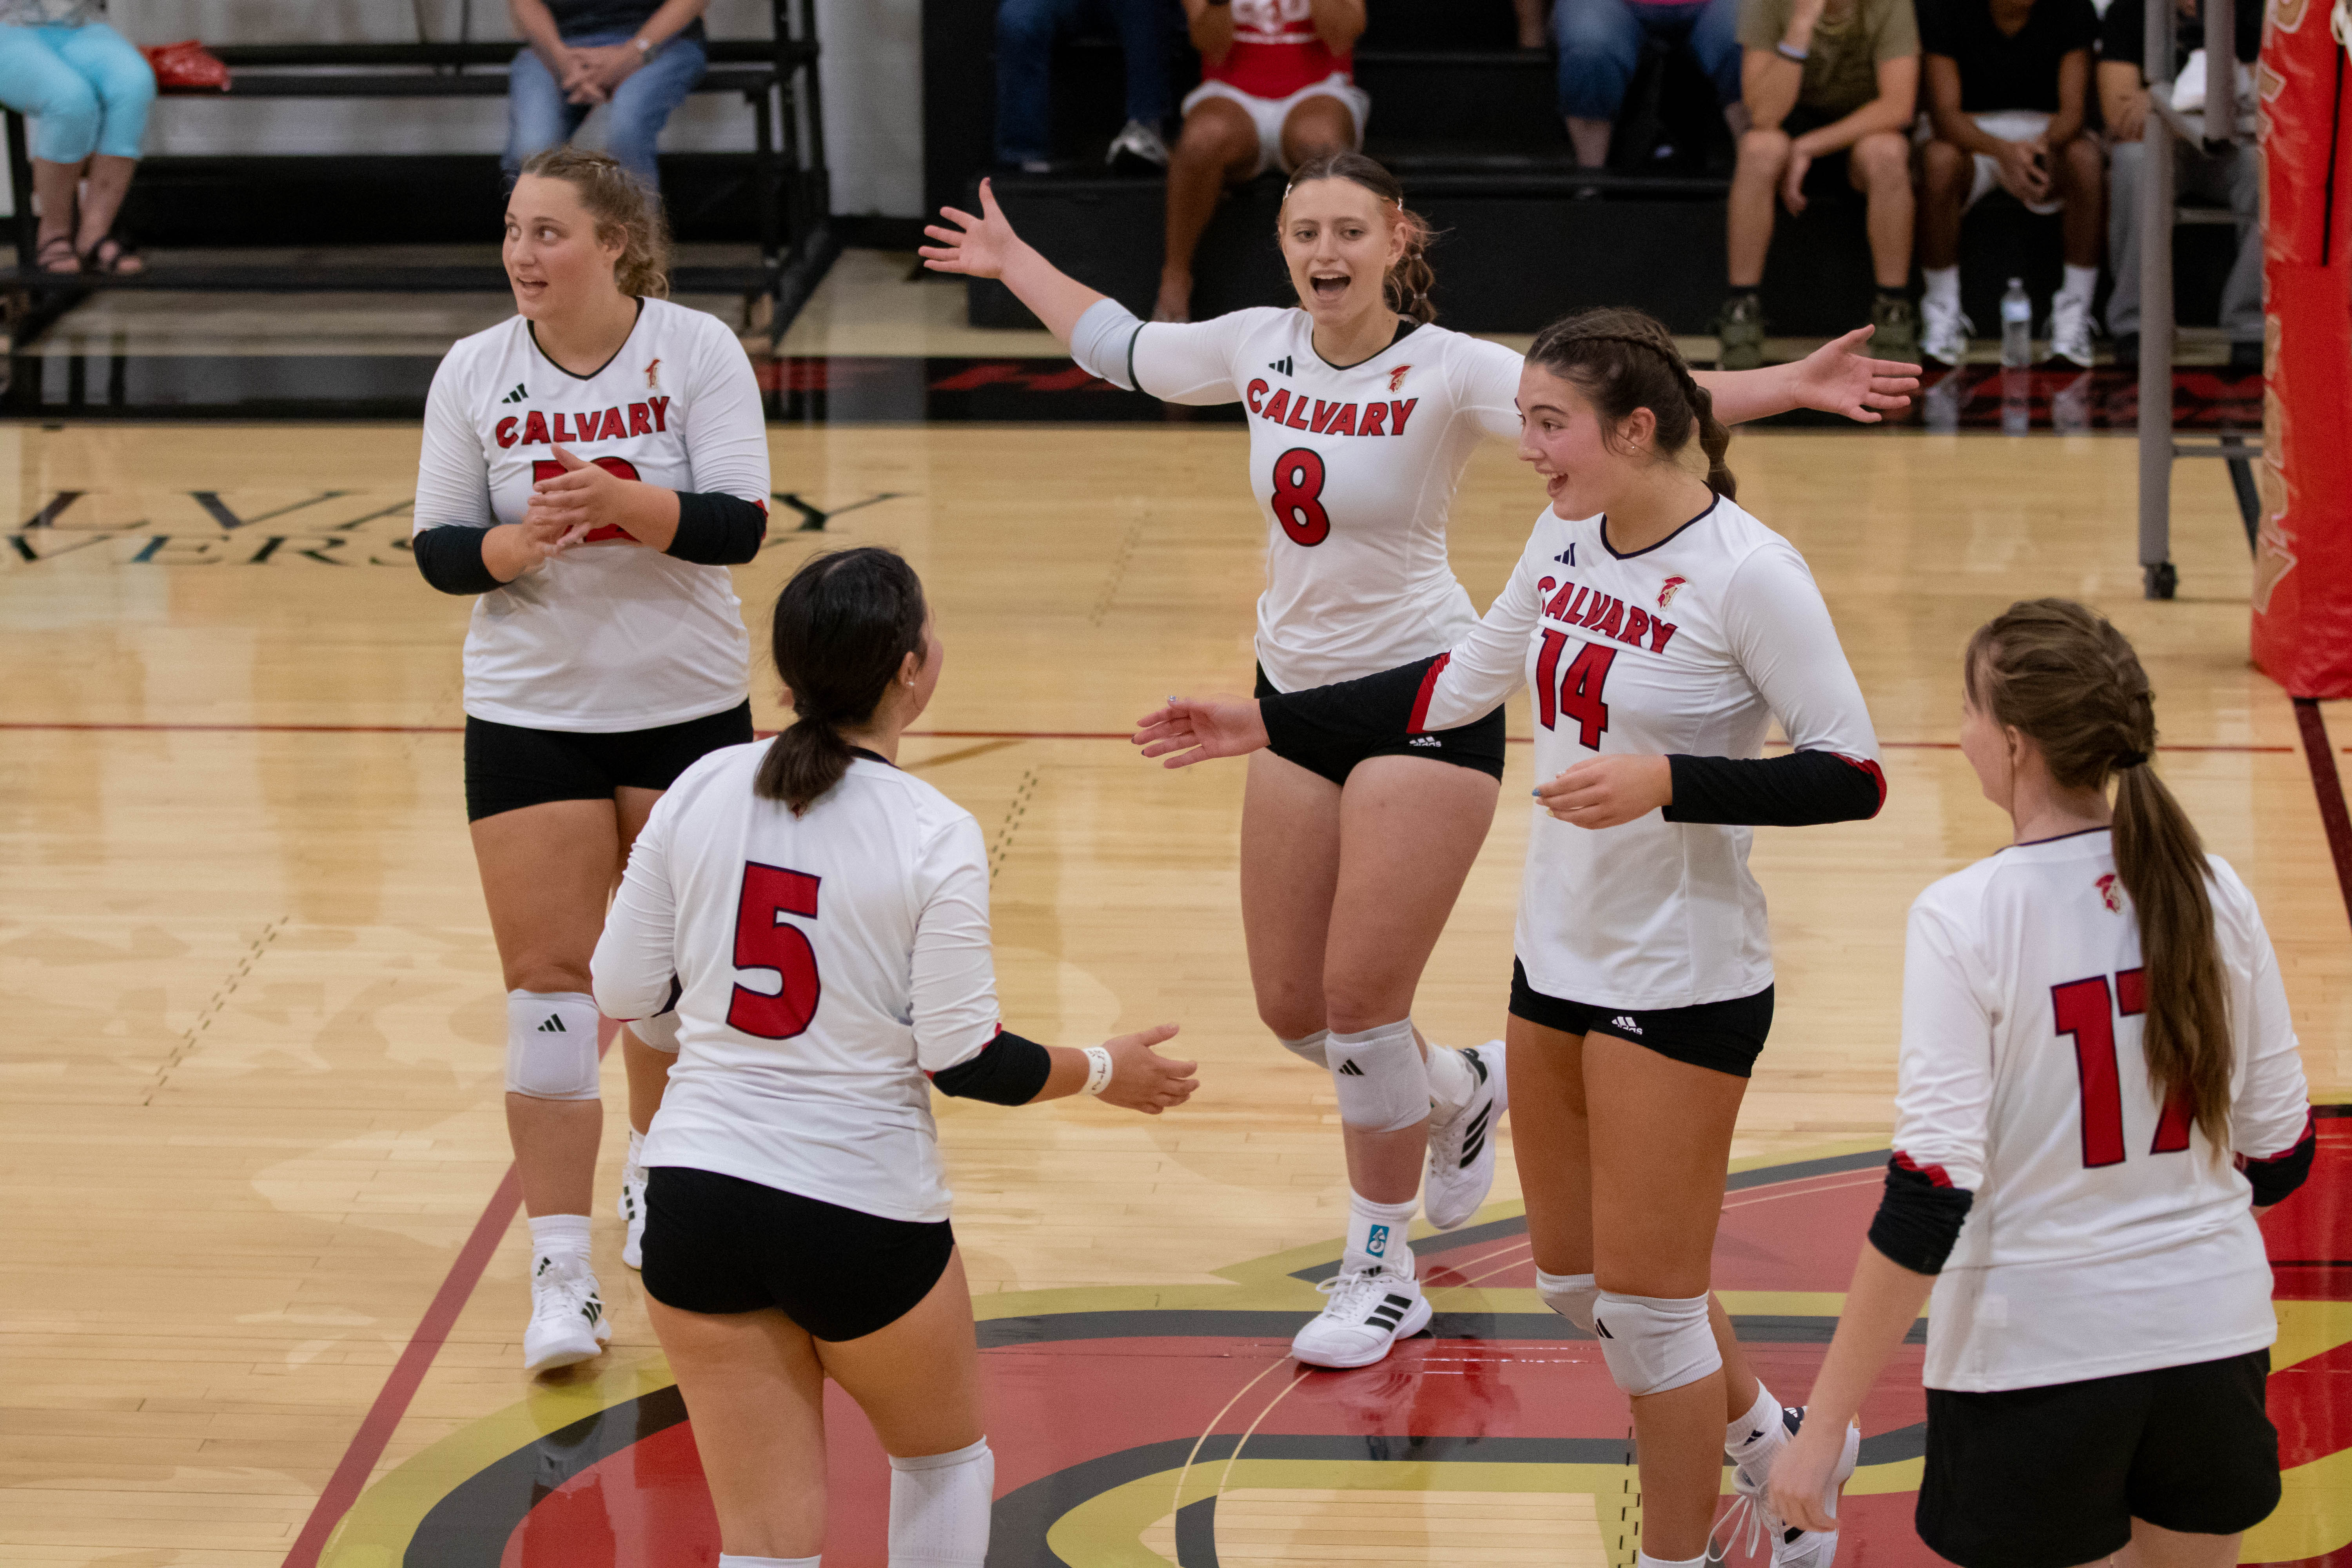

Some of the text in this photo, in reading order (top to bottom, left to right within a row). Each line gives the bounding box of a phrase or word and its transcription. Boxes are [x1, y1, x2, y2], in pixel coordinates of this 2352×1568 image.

[495, 396, 670, 449] CALVARY
[1247, 378, 1419, 436] CALVARY
[1271, 447, 1330, 547] 8
[1536, 627, 1618, 752] 14
[726, 860, 822, 1040] 5
